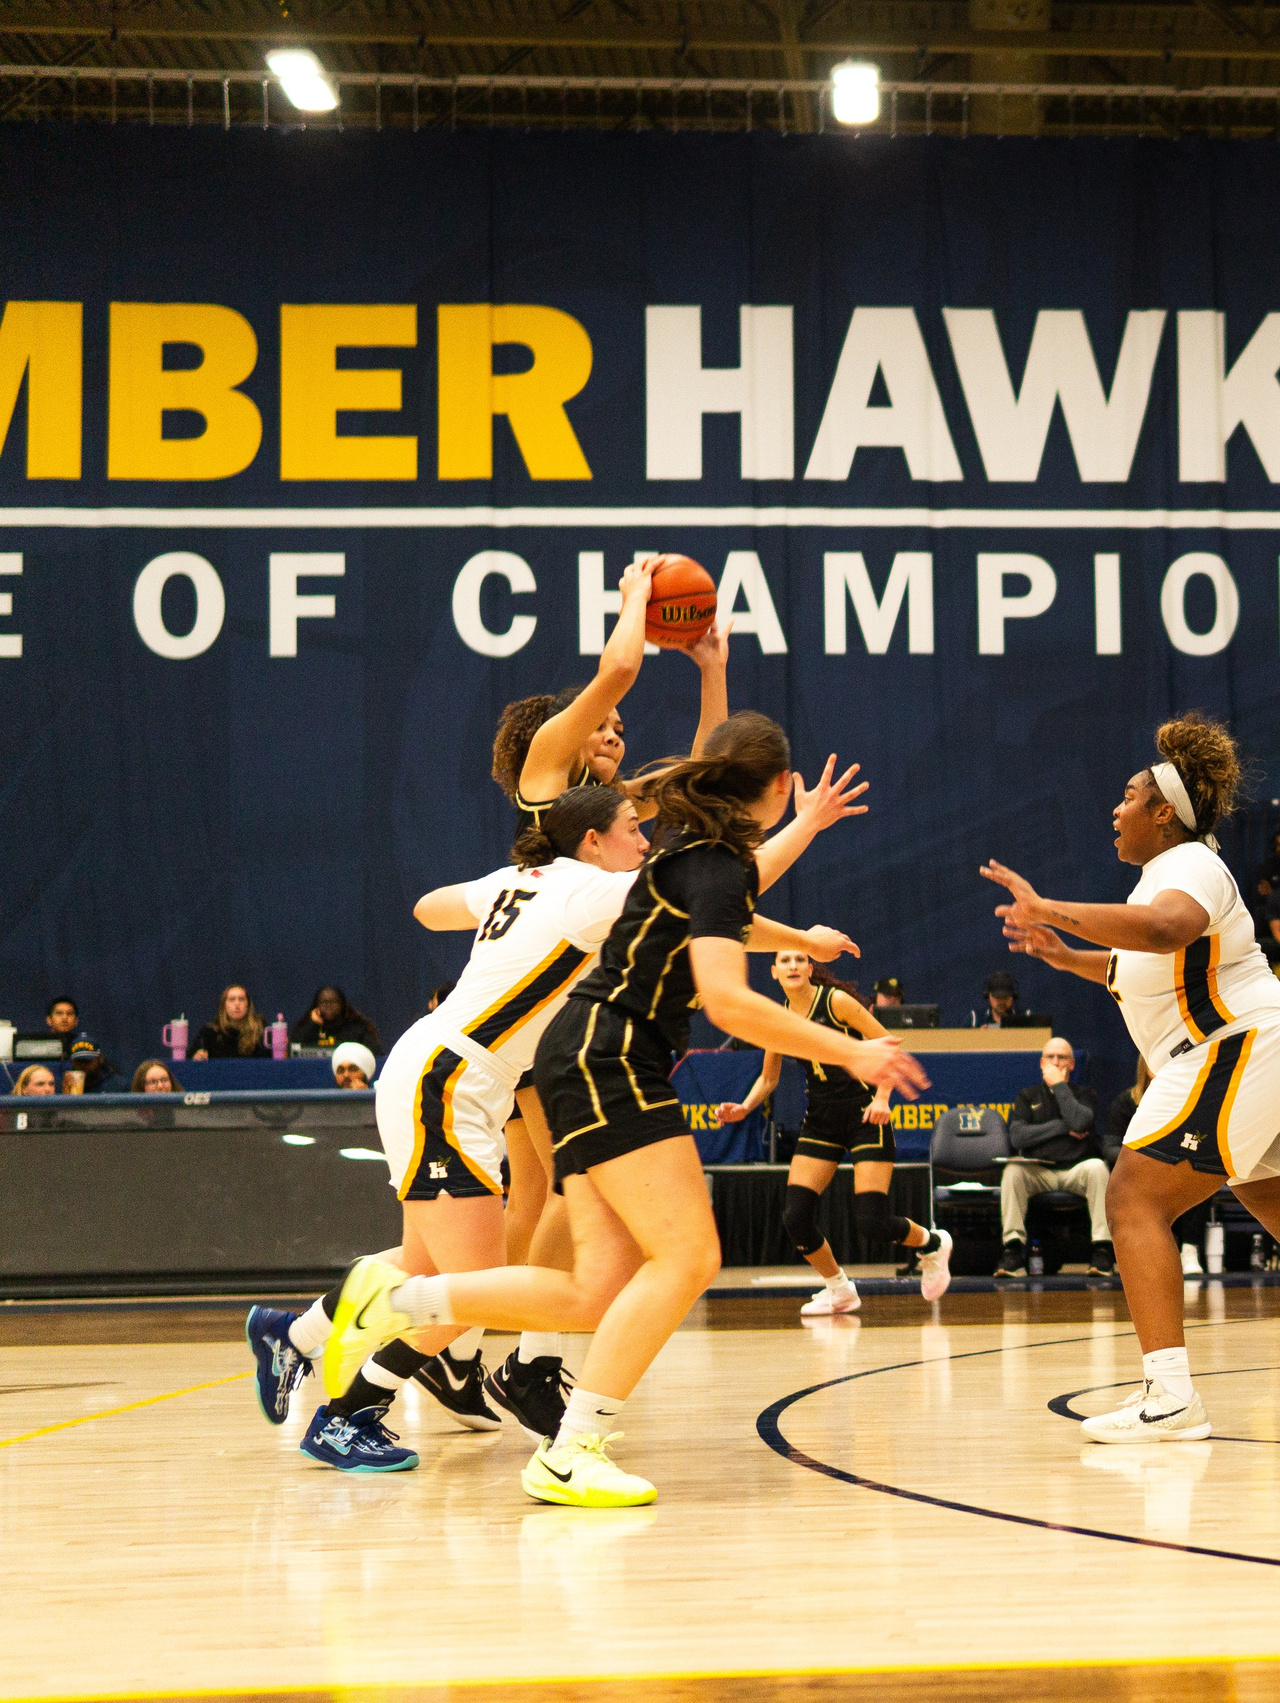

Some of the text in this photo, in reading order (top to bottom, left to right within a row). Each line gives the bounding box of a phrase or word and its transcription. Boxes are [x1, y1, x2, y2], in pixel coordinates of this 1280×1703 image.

[133, 551, 346, 659] OF
[477, 888, 539, 942] 15
[682, 1104, 721, 1130] KS
